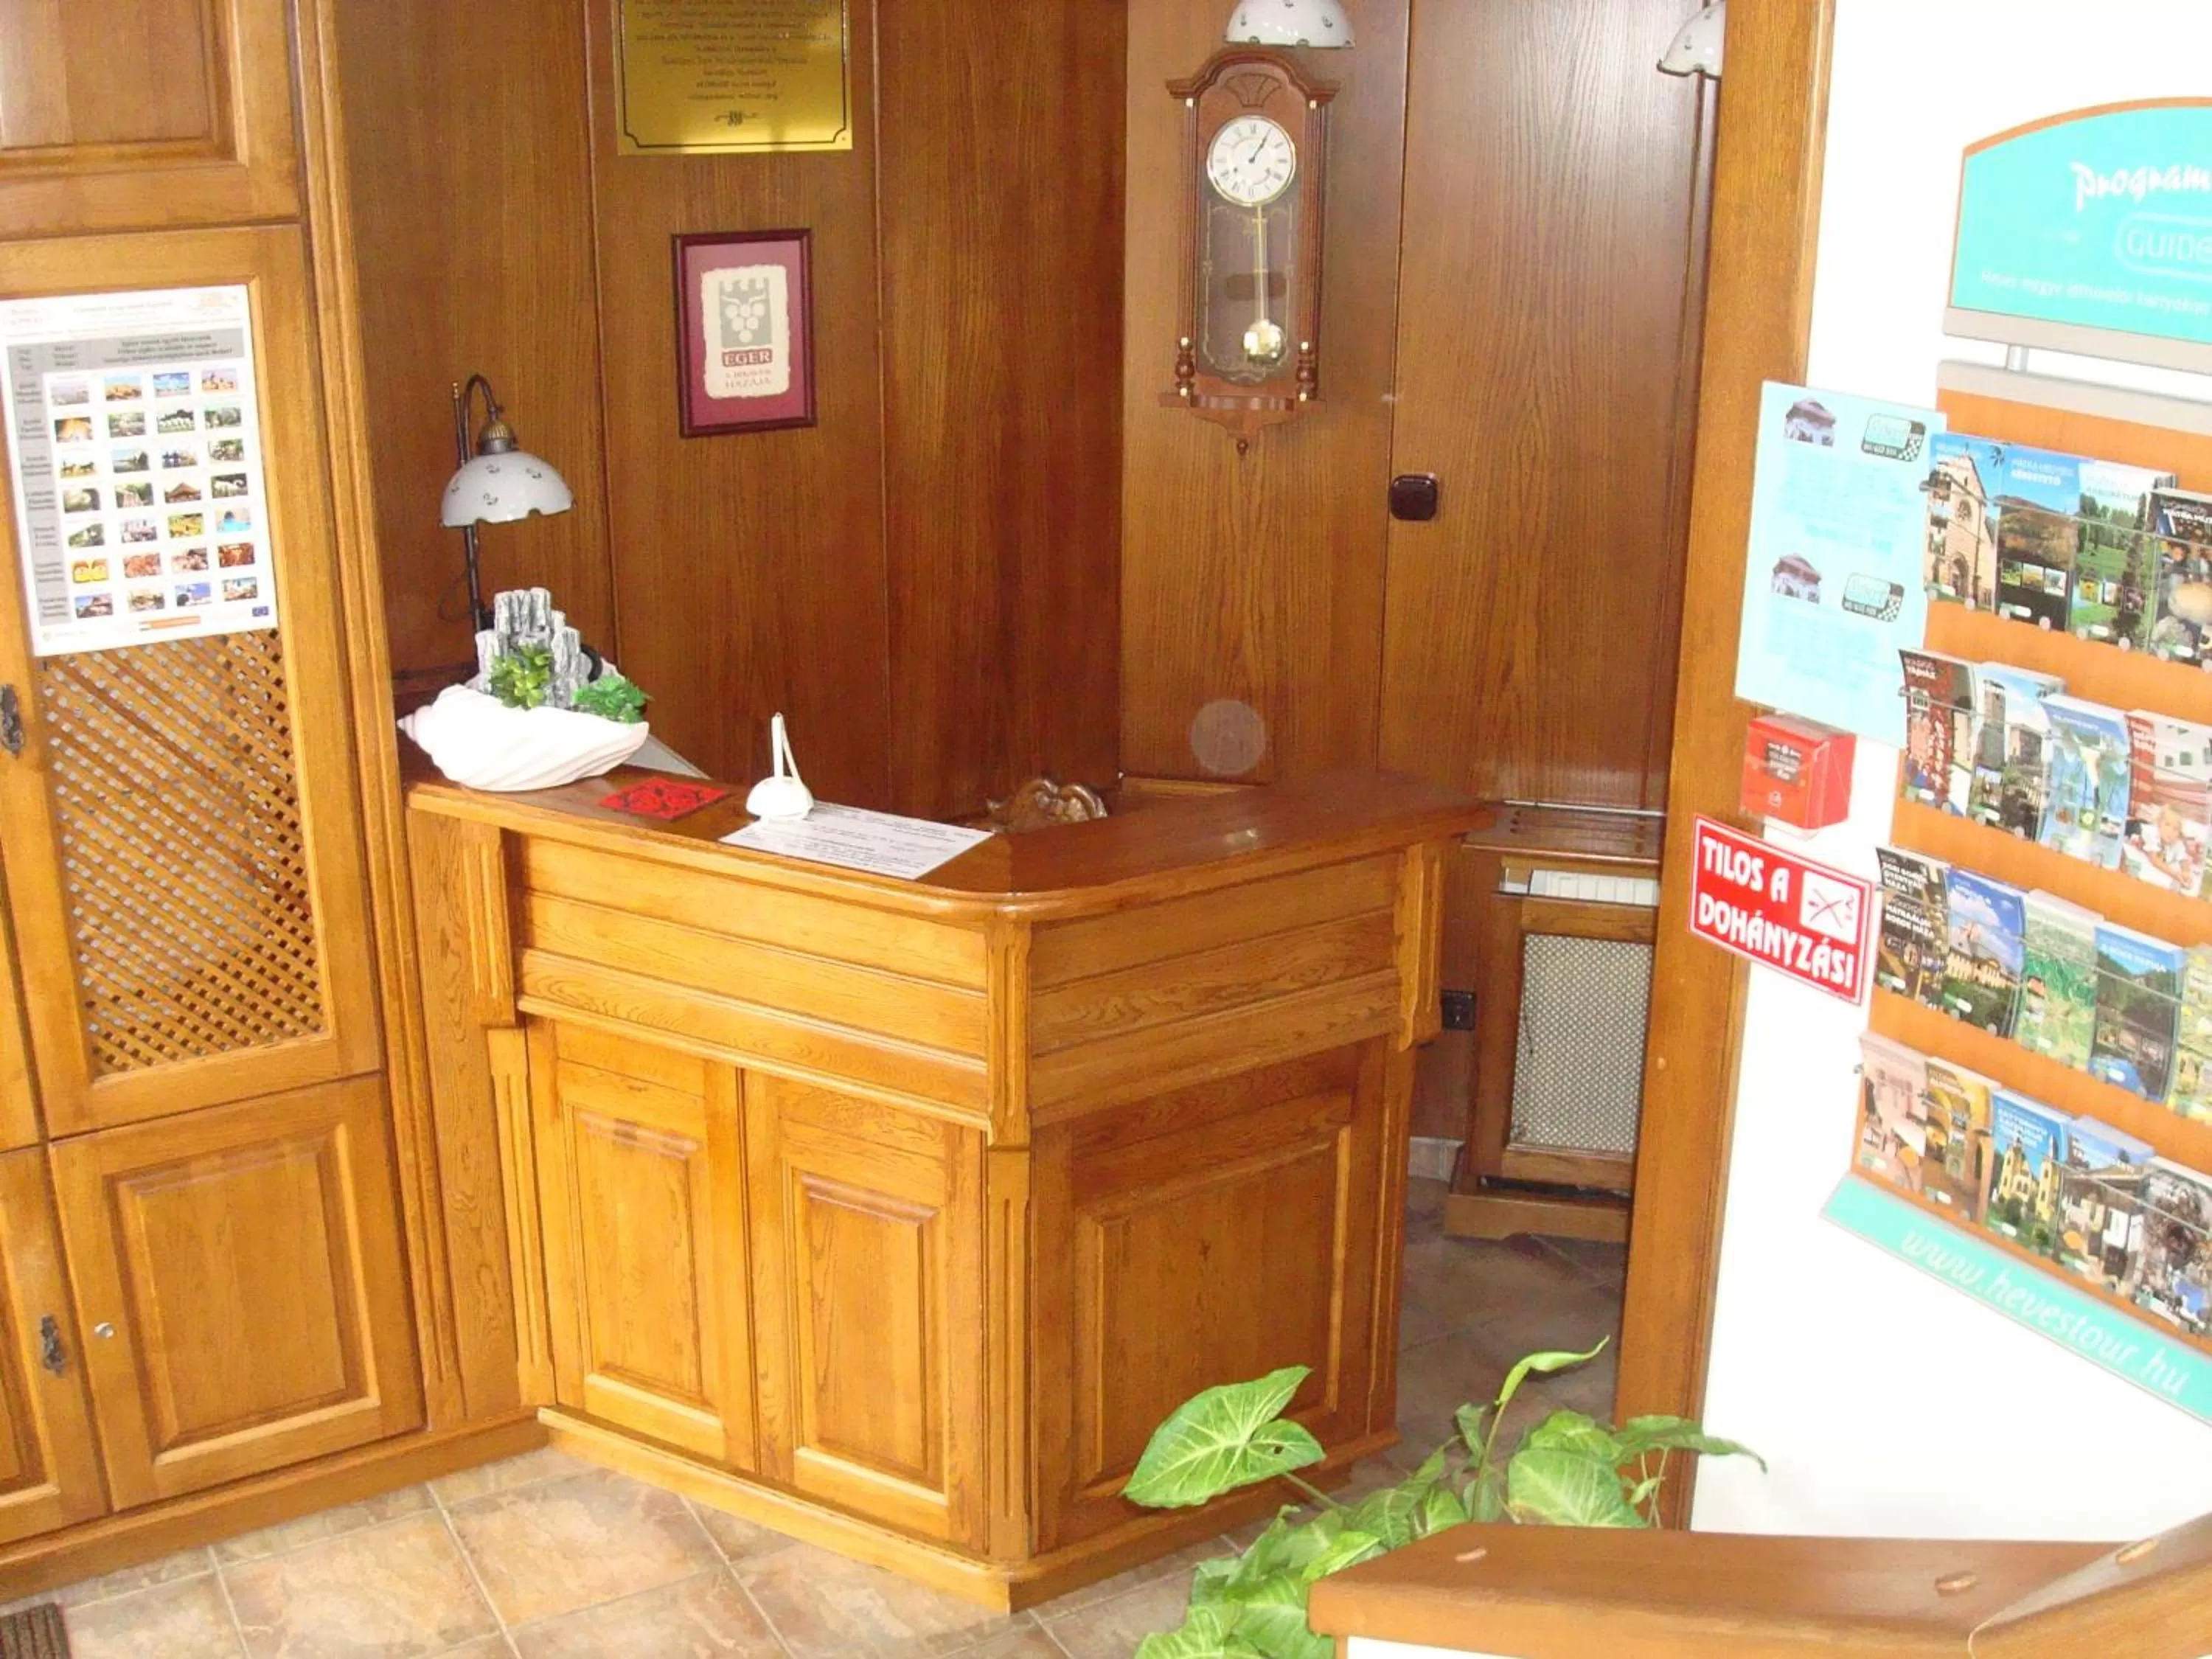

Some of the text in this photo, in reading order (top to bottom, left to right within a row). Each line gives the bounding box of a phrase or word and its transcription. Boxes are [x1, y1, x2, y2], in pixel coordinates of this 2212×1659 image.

[724, 350, 771, 366] EGER
[1702, 835, 1790, 903] TILOS A
